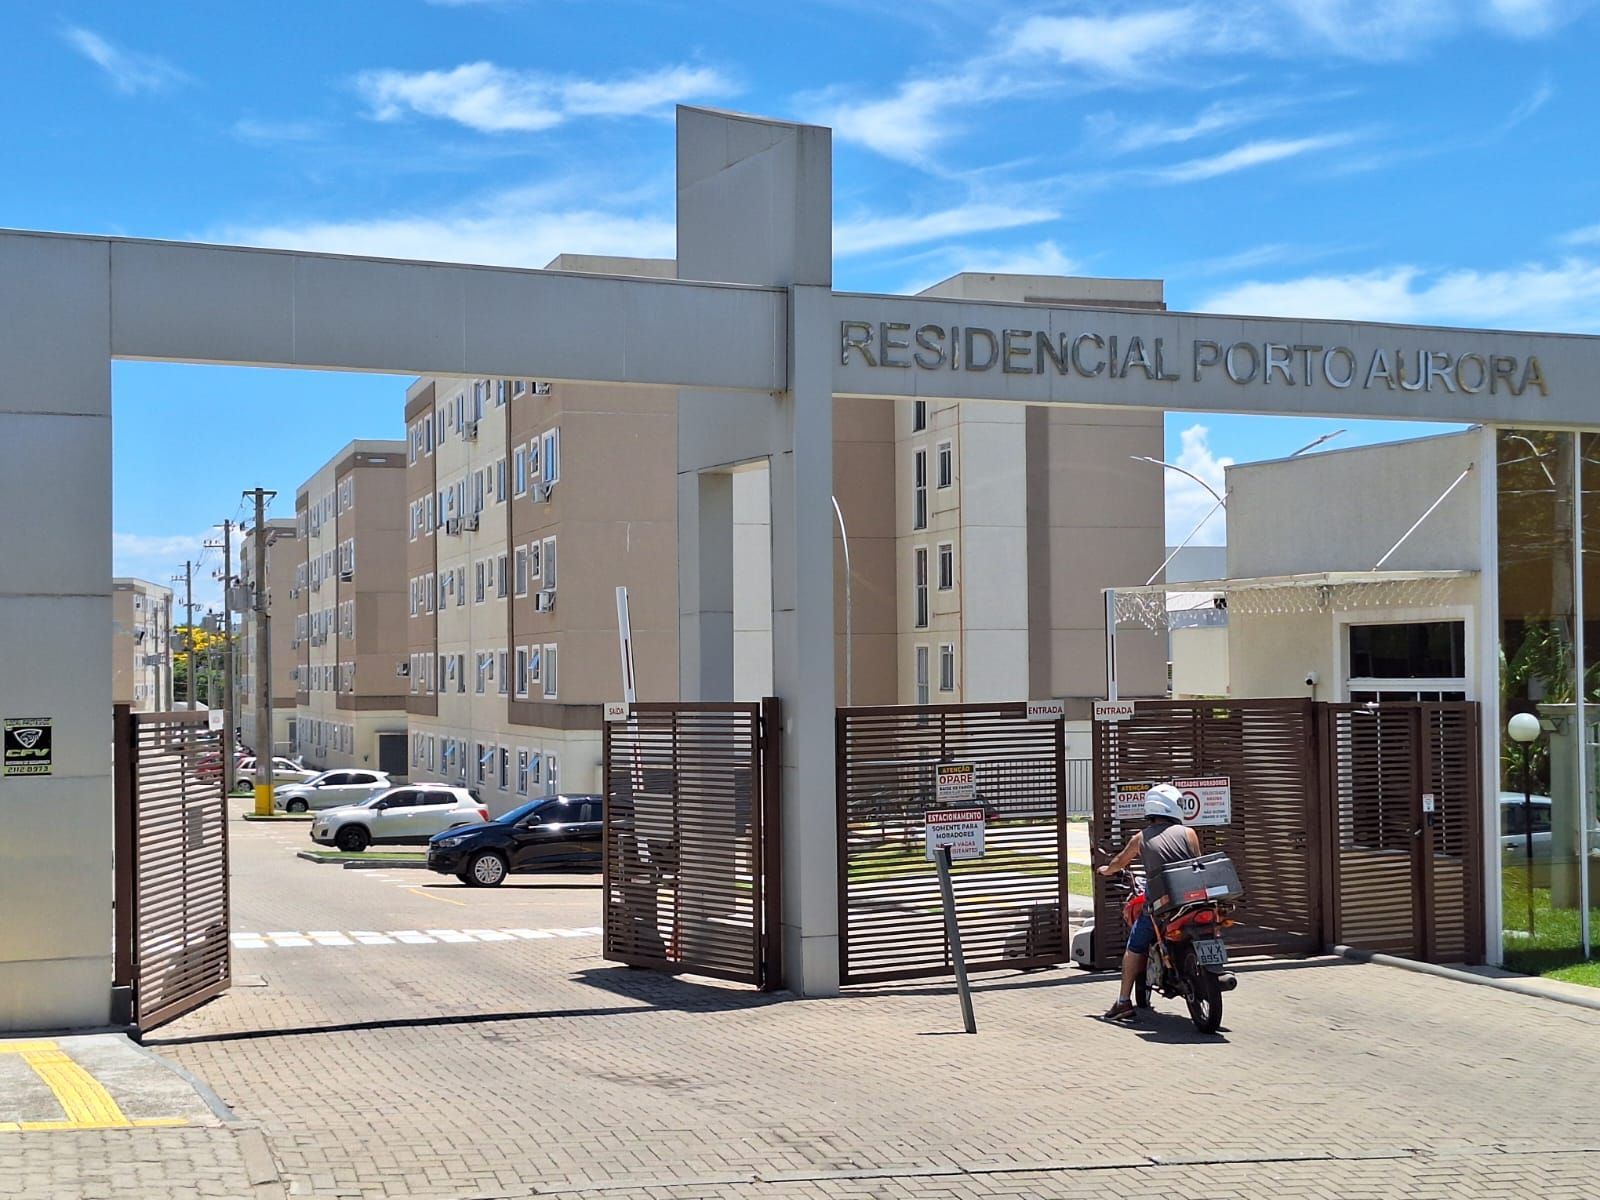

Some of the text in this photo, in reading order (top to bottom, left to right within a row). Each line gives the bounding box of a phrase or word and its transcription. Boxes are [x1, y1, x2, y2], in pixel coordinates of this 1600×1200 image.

[840, 319, 1550, 397] RESIDENCIAL PORTO AURORA
[1028, 706, 1063, 715] ENTRADA
[1096, 706, 1133, 715] ENTRADA
[6, 748, 49, 757] CFV
[939, 774, 973, 785] OPARE
[1118, 792, 1146, 802] OPAR
[927, 811, 982, 823] ESTACIONAMENTO
[931, 824, 960, 832] SOMENTE
[936, 831, 975, 839] MORADORES
